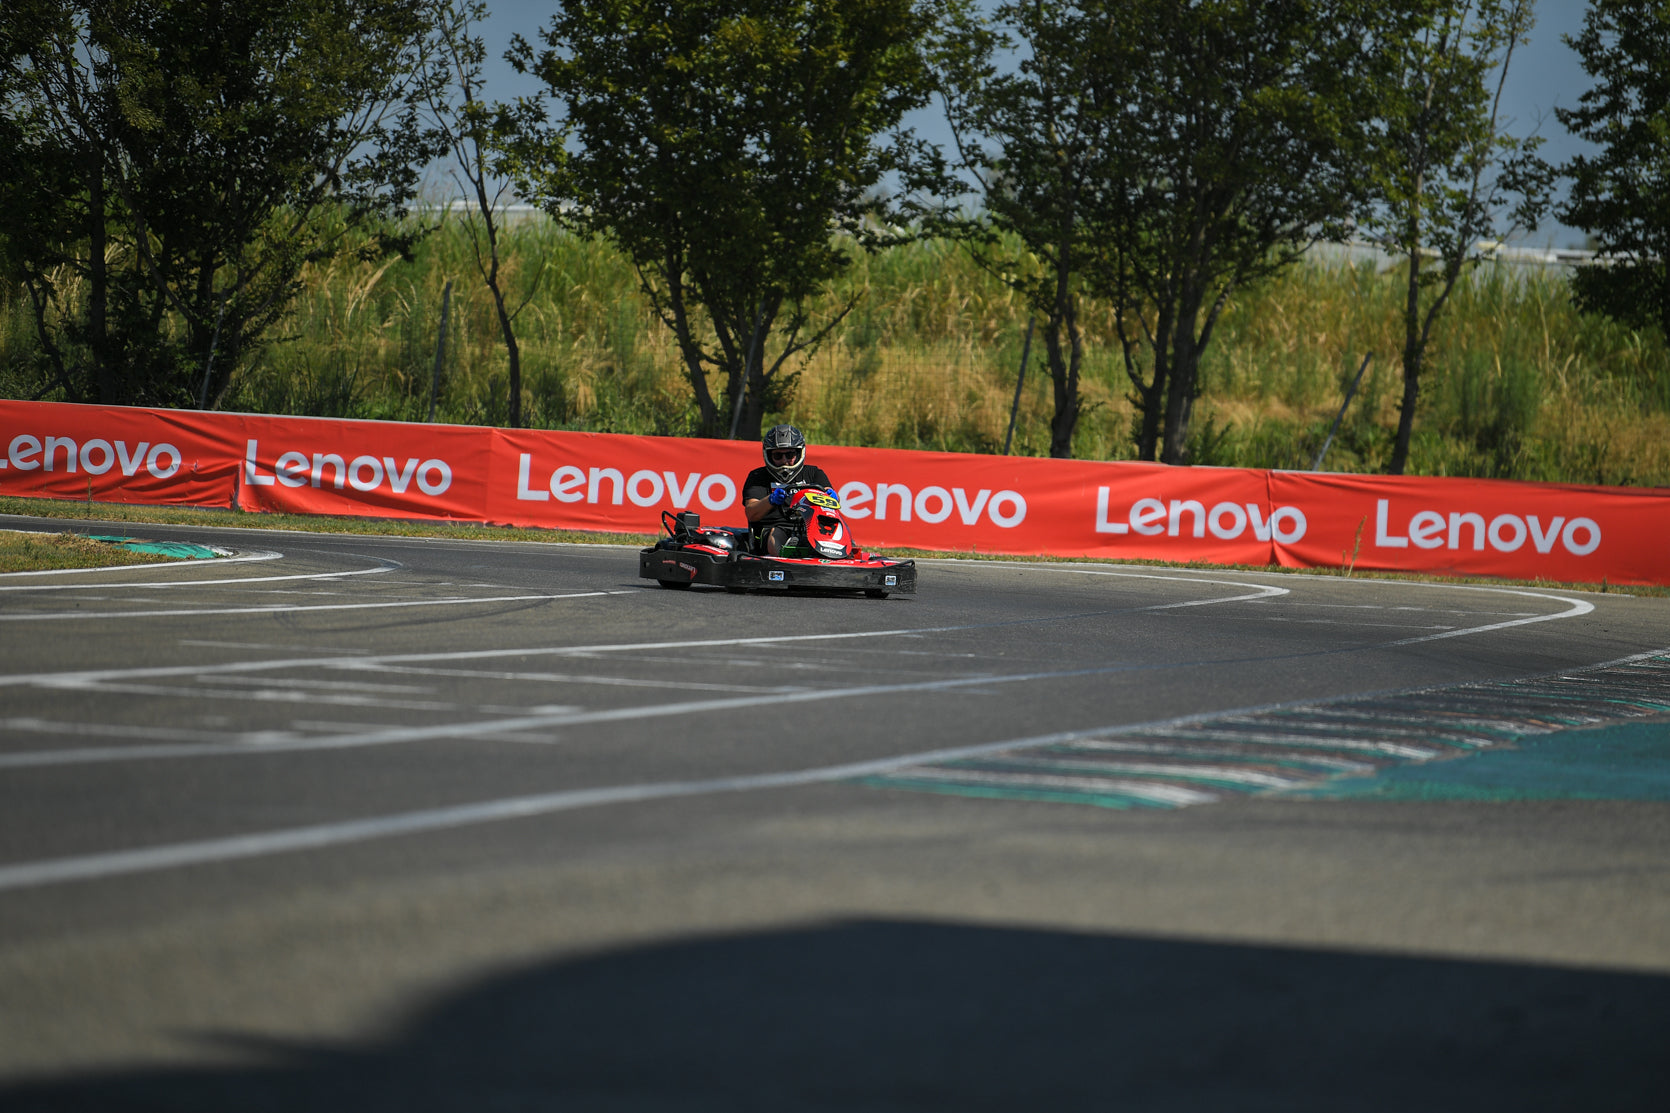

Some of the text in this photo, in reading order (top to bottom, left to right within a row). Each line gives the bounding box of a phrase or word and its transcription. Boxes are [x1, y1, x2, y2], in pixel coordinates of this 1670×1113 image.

[0, 435, 181, 478] enovo
[245, 439, 453, 496] Lenovo
[516, 453, 737, 512] Lenovo
[812, 495, 838, 508] 59
[837, 481, 1028, 529] enovo
[1095, 486, 1308, 545] Lenovo
[1375, 499, 1602, 556] Lenovo
[820, 546, 843, 556] Lenovo
